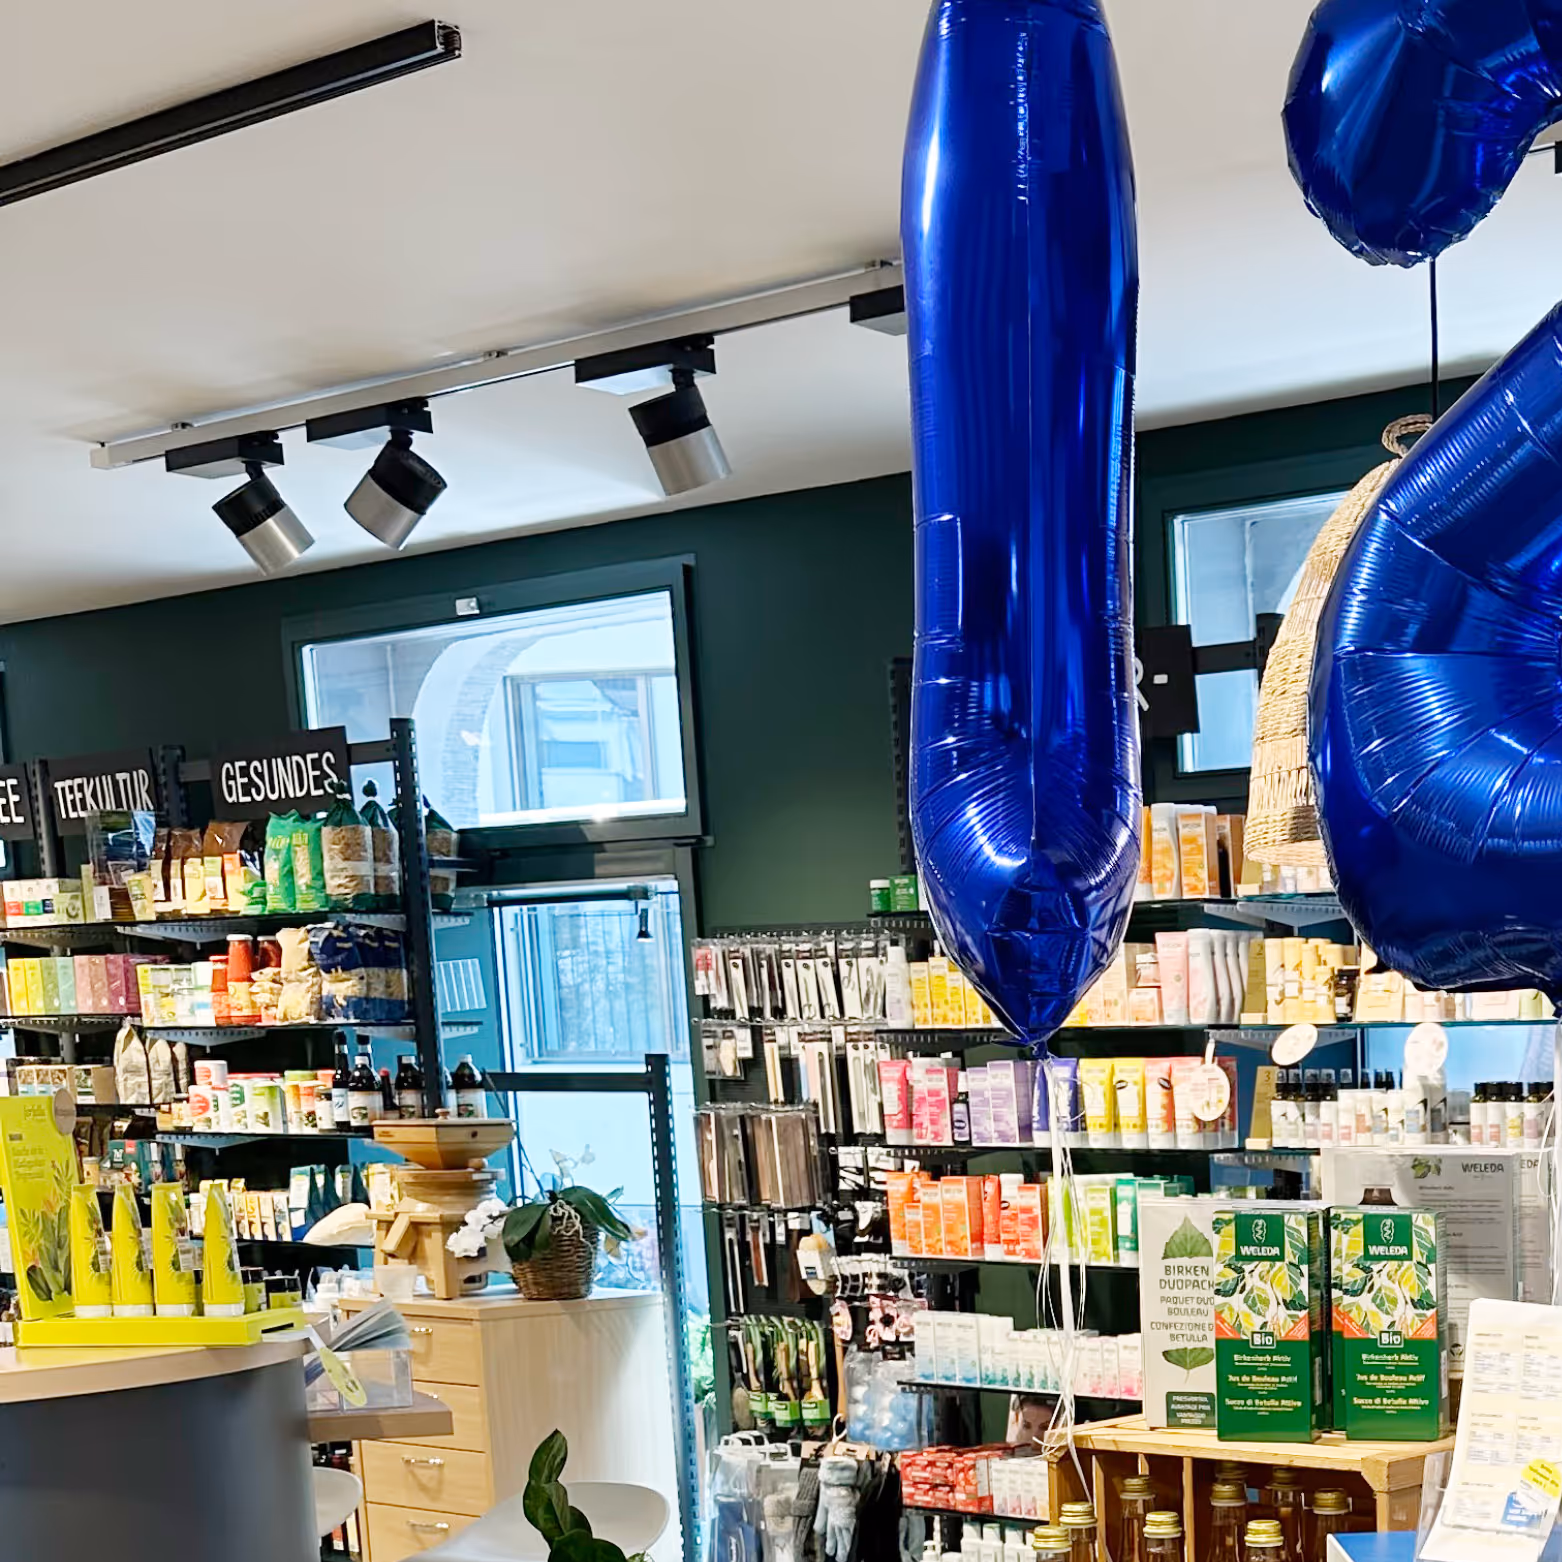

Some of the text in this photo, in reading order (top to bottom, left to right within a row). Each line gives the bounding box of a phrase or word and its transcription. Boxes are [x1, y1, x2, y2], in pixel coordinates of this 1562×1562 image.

[221, 751, 338, 804] GESUNDES
[53, 768, 156, 820] TEEKULTUR
[1461, 1161, 1505, 1174] WELEDA
[1239, 1246, 1280, 1257] WELEDA
[1368, 1245, 1409, 1256] WELEDA
[1164, 1265, 1209, 1276] BIRKEN
[1253, 1333, 1273, 1345] Bio
[1381, 1332, 1401, 1345] Bio
